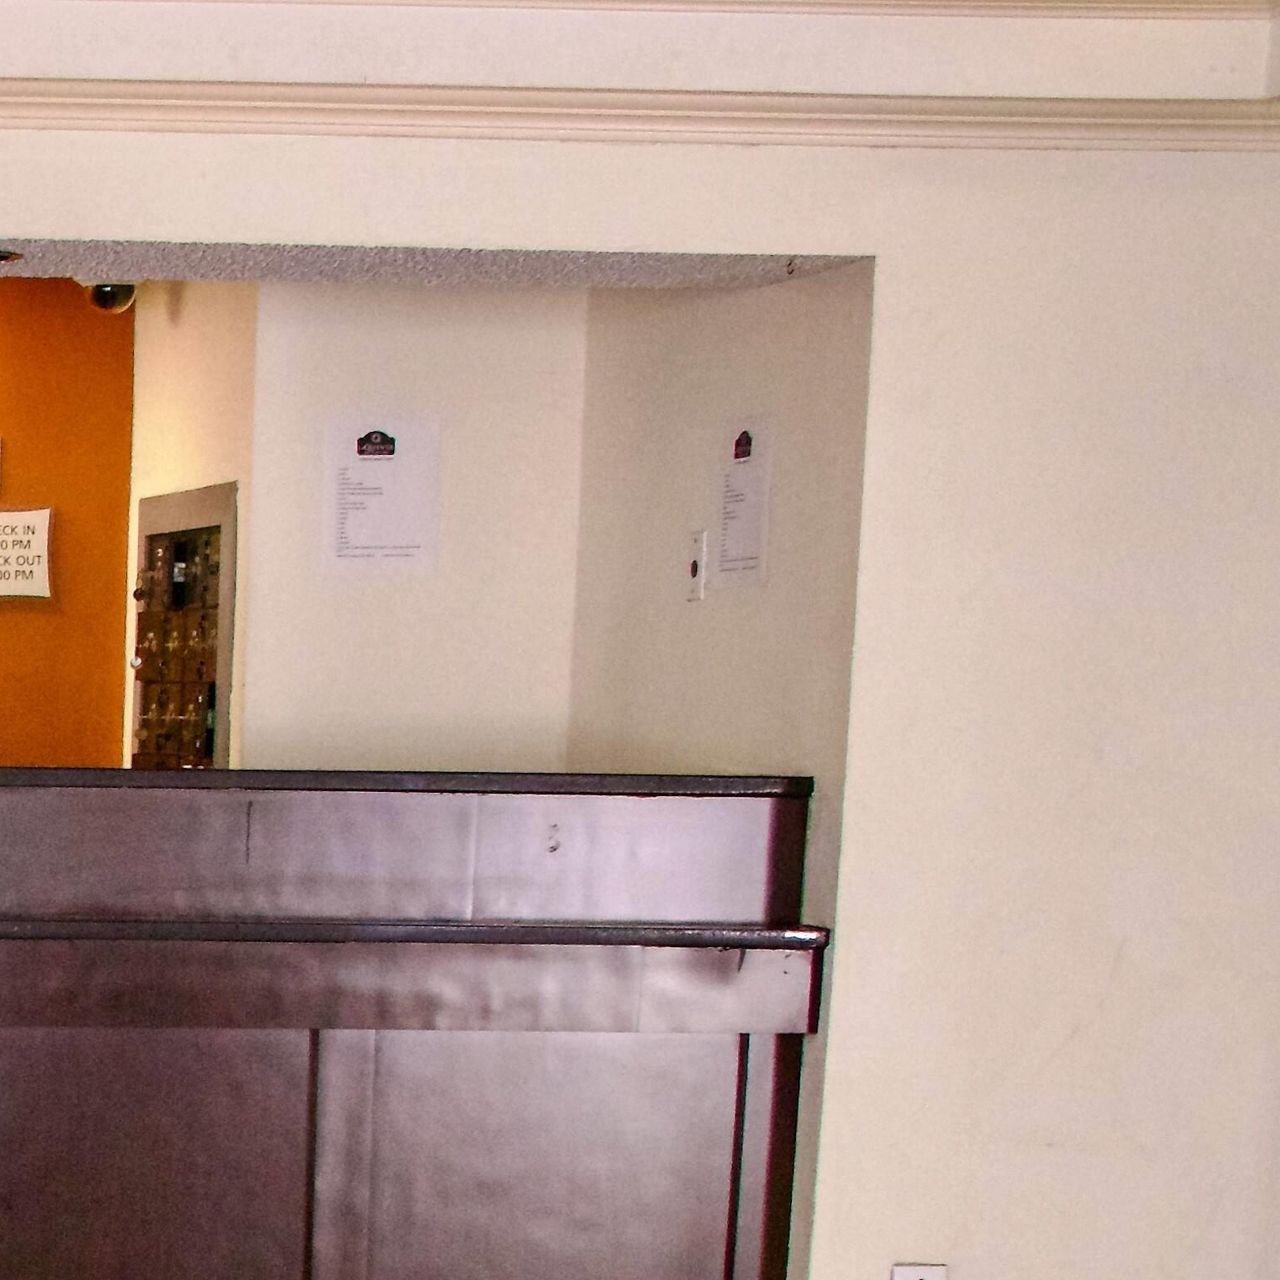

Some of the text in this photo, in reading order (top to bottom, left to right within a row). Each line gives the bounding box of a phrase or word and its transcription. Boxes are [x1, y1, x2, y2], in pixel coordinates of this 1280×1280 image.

[23, 525, 36, 536] IN
[12, 540, 31, 550] PM
[16, 555, 41, 566] OUT
[14, 570, 34, 580] PM
